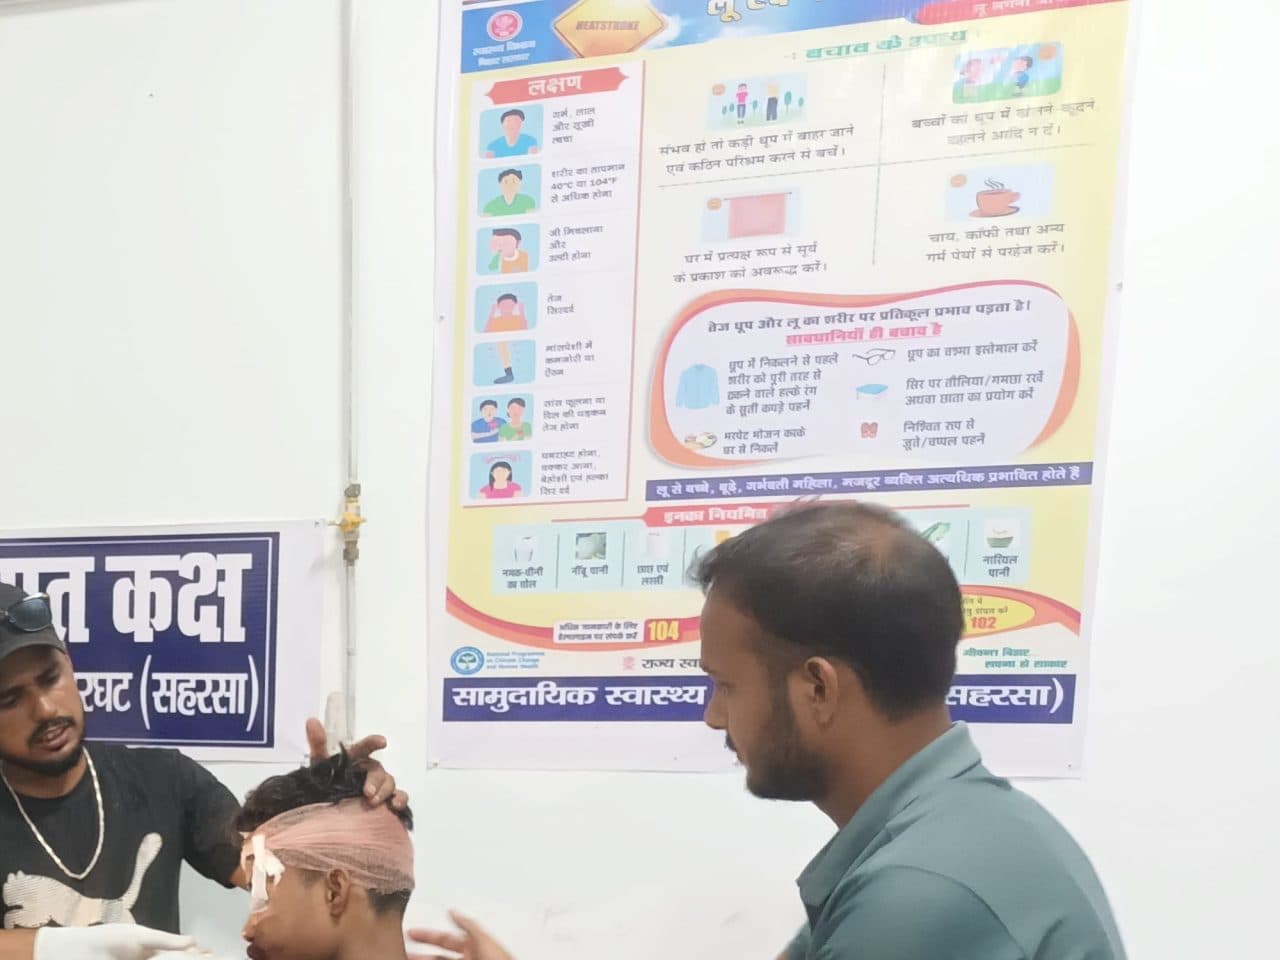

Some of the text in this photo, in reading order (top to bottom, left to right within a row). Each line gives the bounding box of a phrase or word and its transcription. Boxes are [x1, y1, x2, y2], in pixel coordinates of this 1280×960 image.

[528, 75, 583, 96] लक्षण
[728, 135, 753, 151] कड़ी
[759, 134, 778, 149] धूप
[797, 130, 826, 140] बाहर
[688, 158, 720, 172] कठिन
[1005, 226, 1031, 236] तथा
[1037, 224, 1064, 234] अन्य
[685, 255, 700, 263] घर
[690, 271, 725, 282] प्रकाश
[708, 303, 1010, 335] तेज धूप और लू का शरीर पर प्रतिकूल प्रभाव पड़ता
[908, 349, 923, 362] धूप
[926, 348, 940, 357] का
[975, 342, 1018, 355] इस्तेमाल
[1022, 339, 1038, 352] करें
[729, 361, 744, 373] धूप
[760, 355, 798, 368] निकलने
[802, 354, 810, 365] से
[815, 352, 839, 364] पहले
[754, 372, 766, 383] को
[771, 371, 787, 385] पूरी
[790, 371, 809, 381] तरह
[813, 369, 821, 380] से
[906, 378, 925, 390] सिर
[928, 379, 942, 388] पर
[804, 384, 817, 395] रंग
[940, 394, 964, 404] छाता
[968, 392, 982, 401] का
[986, 389, 1016, 401] प्रयोग
[740, 403, 758, 417] सूती
[761, 401, 784, 414] कपड़े
[966, 418, 975, 429] से
[725, 429, 749, 440] भरपेट
[753, 428, 780, 439] भोजन
[724, 446, 736, 455] घर
[657, 485, 669, 497] लू
[672, 483, 682, 495] से
[746, 478, 789, 491] गर्भवती
[842, 476, 880, 489] मजदूर
[884, 472, 923, 485] व्यक्ति
[927, 471, 986, 484] अत्यधिक
[989, 470, 1038, 482] प्रभावित
[1041, 467, 1066, 481] होते
[664, 509, 704, 523] इनका
[983, 554, 1018, 565] नारियल
[590, 565, 608, 575] पानी
[988, 567, 1010, 578] पानी
[105, 551, 253, 643] कक्ष
[971, 617, 997, 629] 102
[648, 621, 679, 641] 104
[642, 659, 674, 669] राज्य
[73, 672, 133, 712] रघट
[140, 654, 259, 732] (सहरसा)
[452, 677, 1064, 714] सामुदायिक स्वास्थ्य सहरसा)
